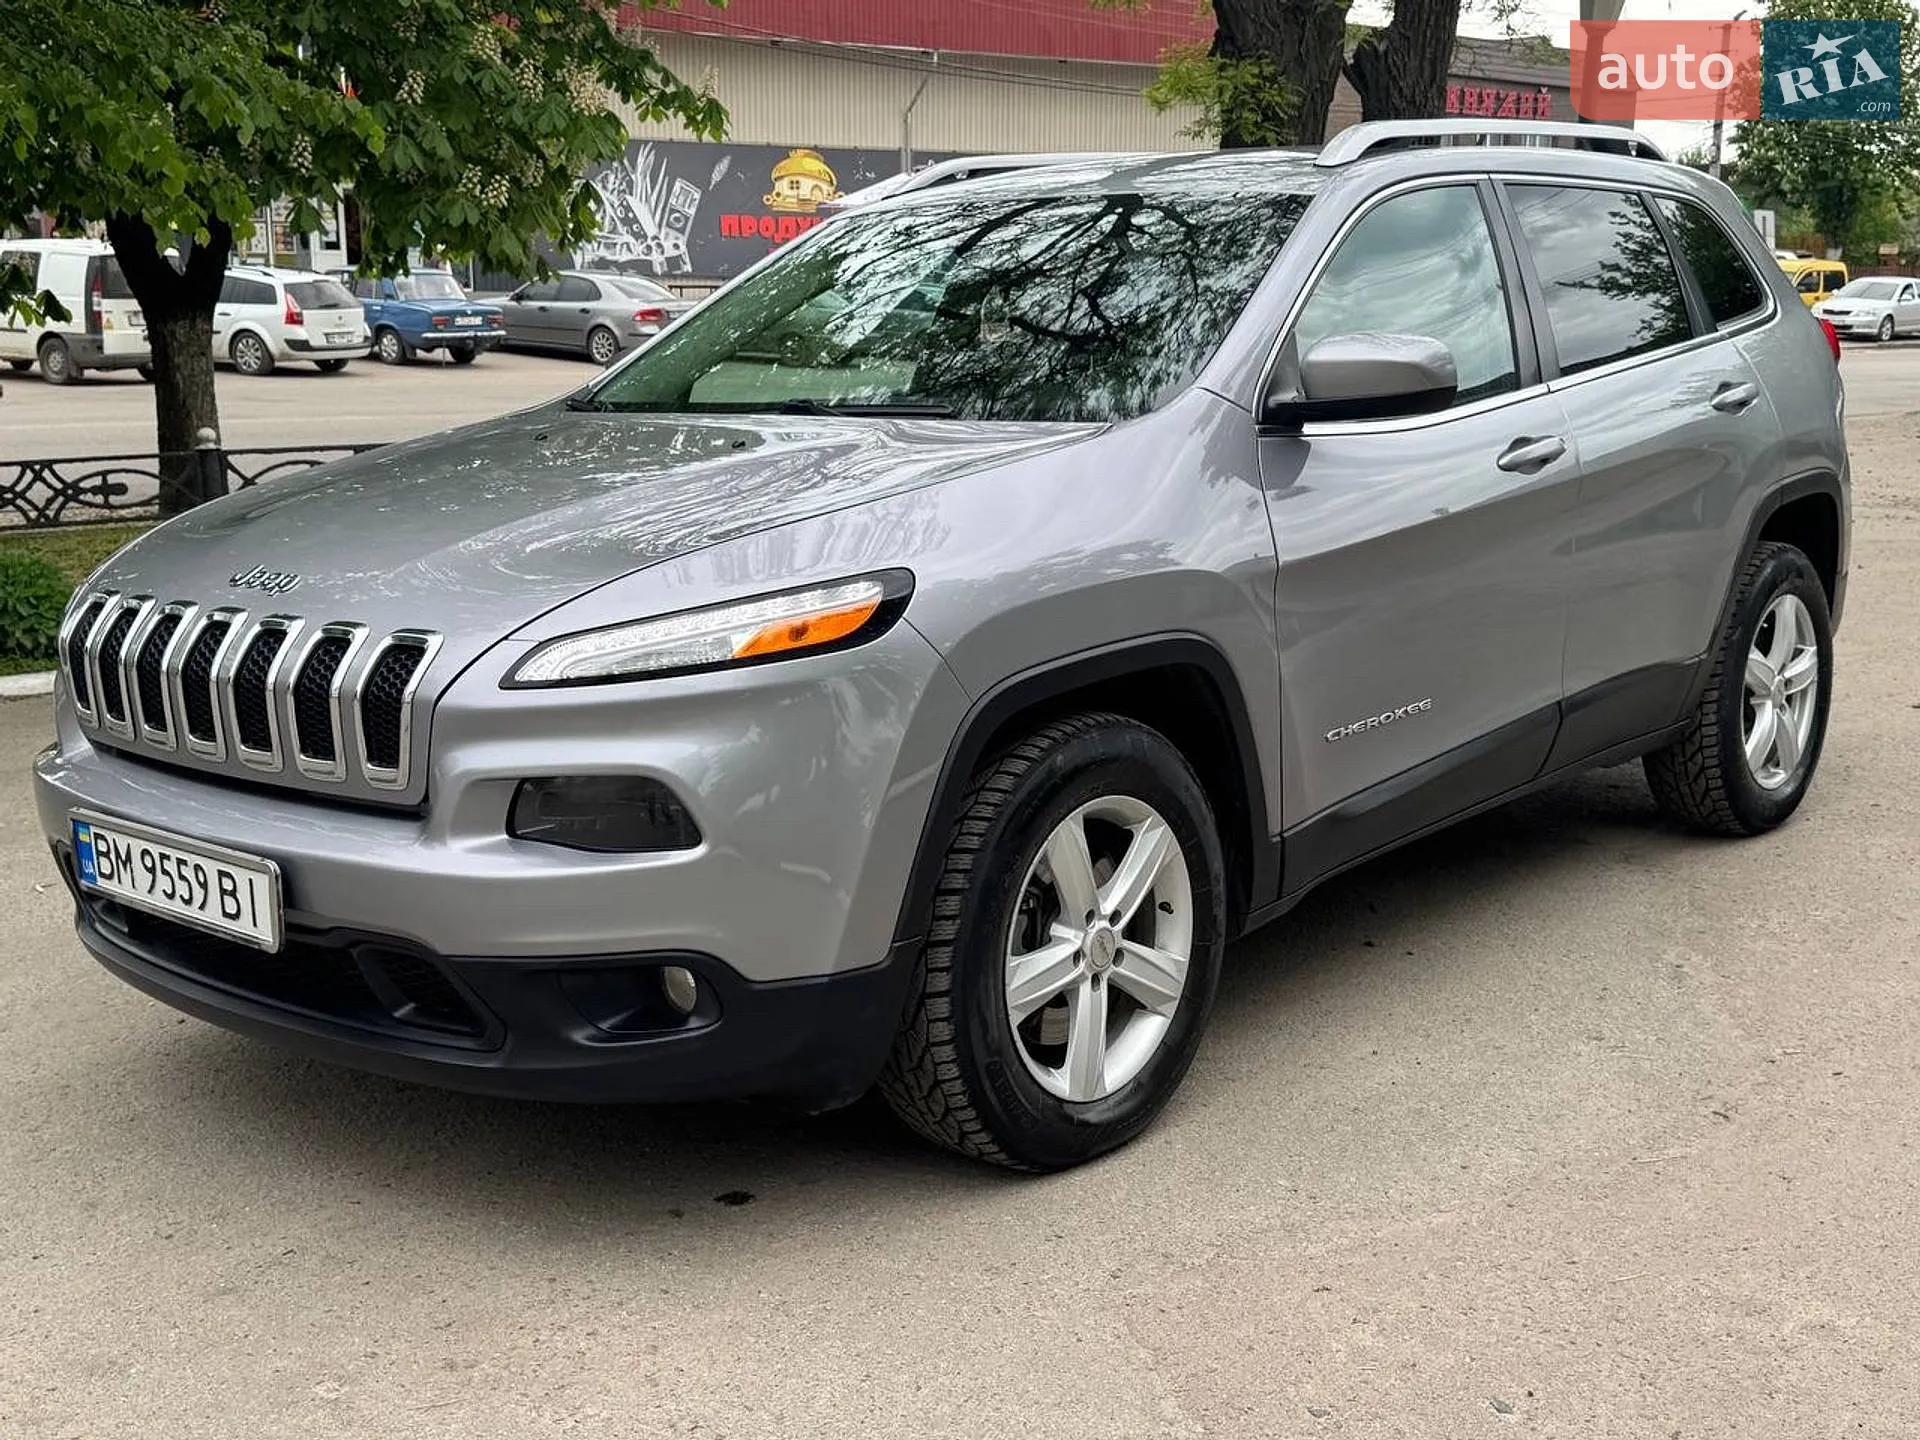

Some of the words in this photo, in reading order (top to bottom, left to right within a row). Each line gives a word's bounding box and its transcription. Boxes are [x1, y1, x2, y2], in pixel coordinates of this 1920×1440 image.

[229, 565, 301, 597] Jeep
[1326, 698, 1432, 742] CHEROKEE
[92, 831, 136, 890] BM
[140, 848, 208, 911] 9559
[216, 868, 258, 928] BI
